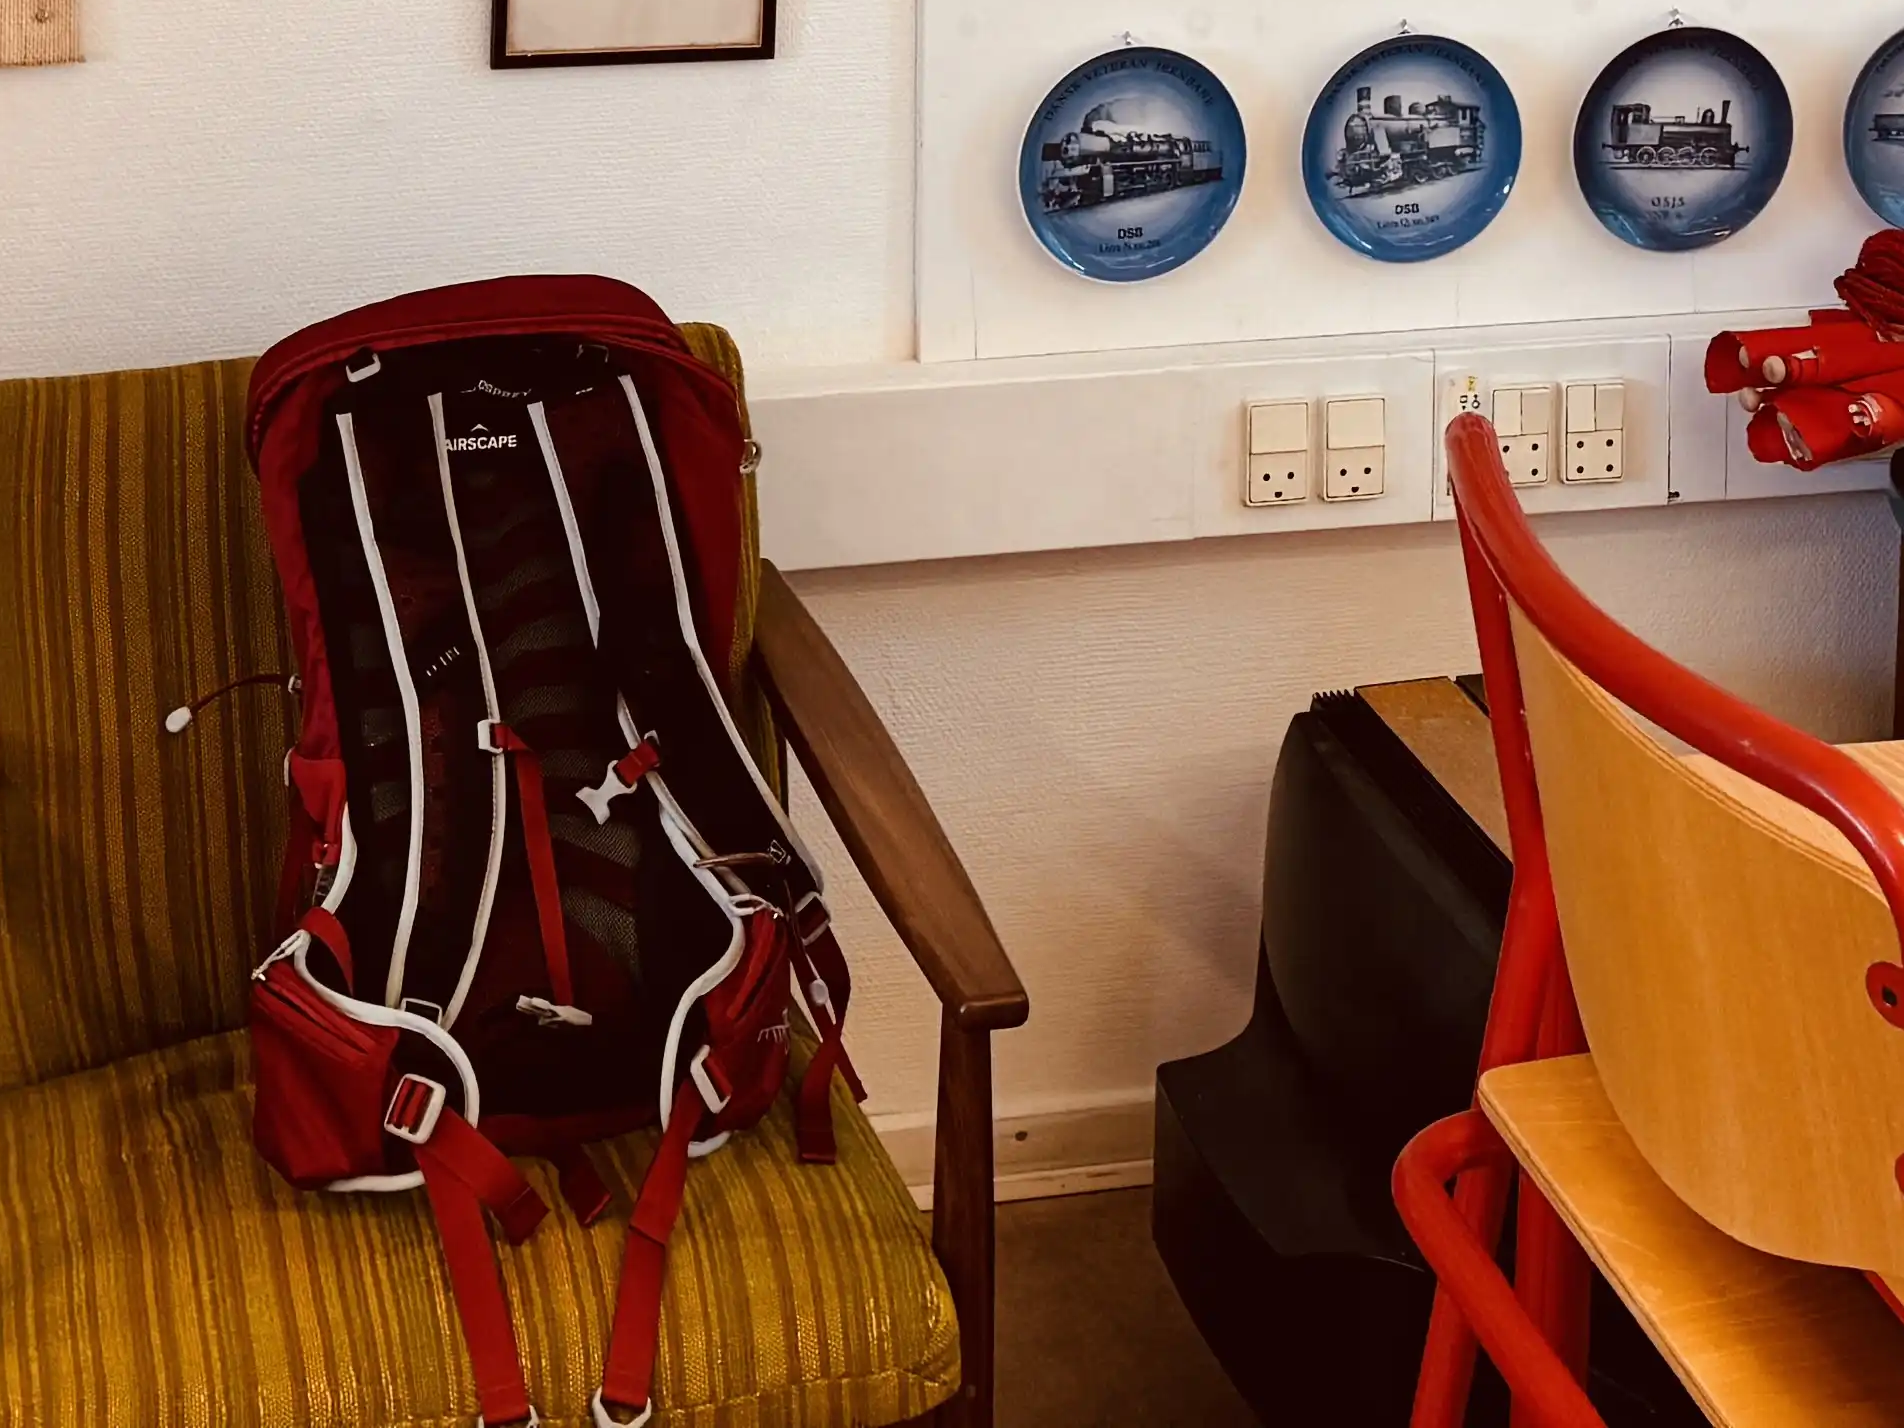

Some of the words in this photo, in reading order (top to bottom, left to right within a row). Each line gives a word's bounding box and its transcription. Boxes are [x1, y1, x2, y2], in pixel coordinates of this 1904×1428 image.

[1395, 203, 1419, 214] DSB
[1118, 227, 1143, 239] DSB
[446, 435, 517, 451] AIRSCAPE
